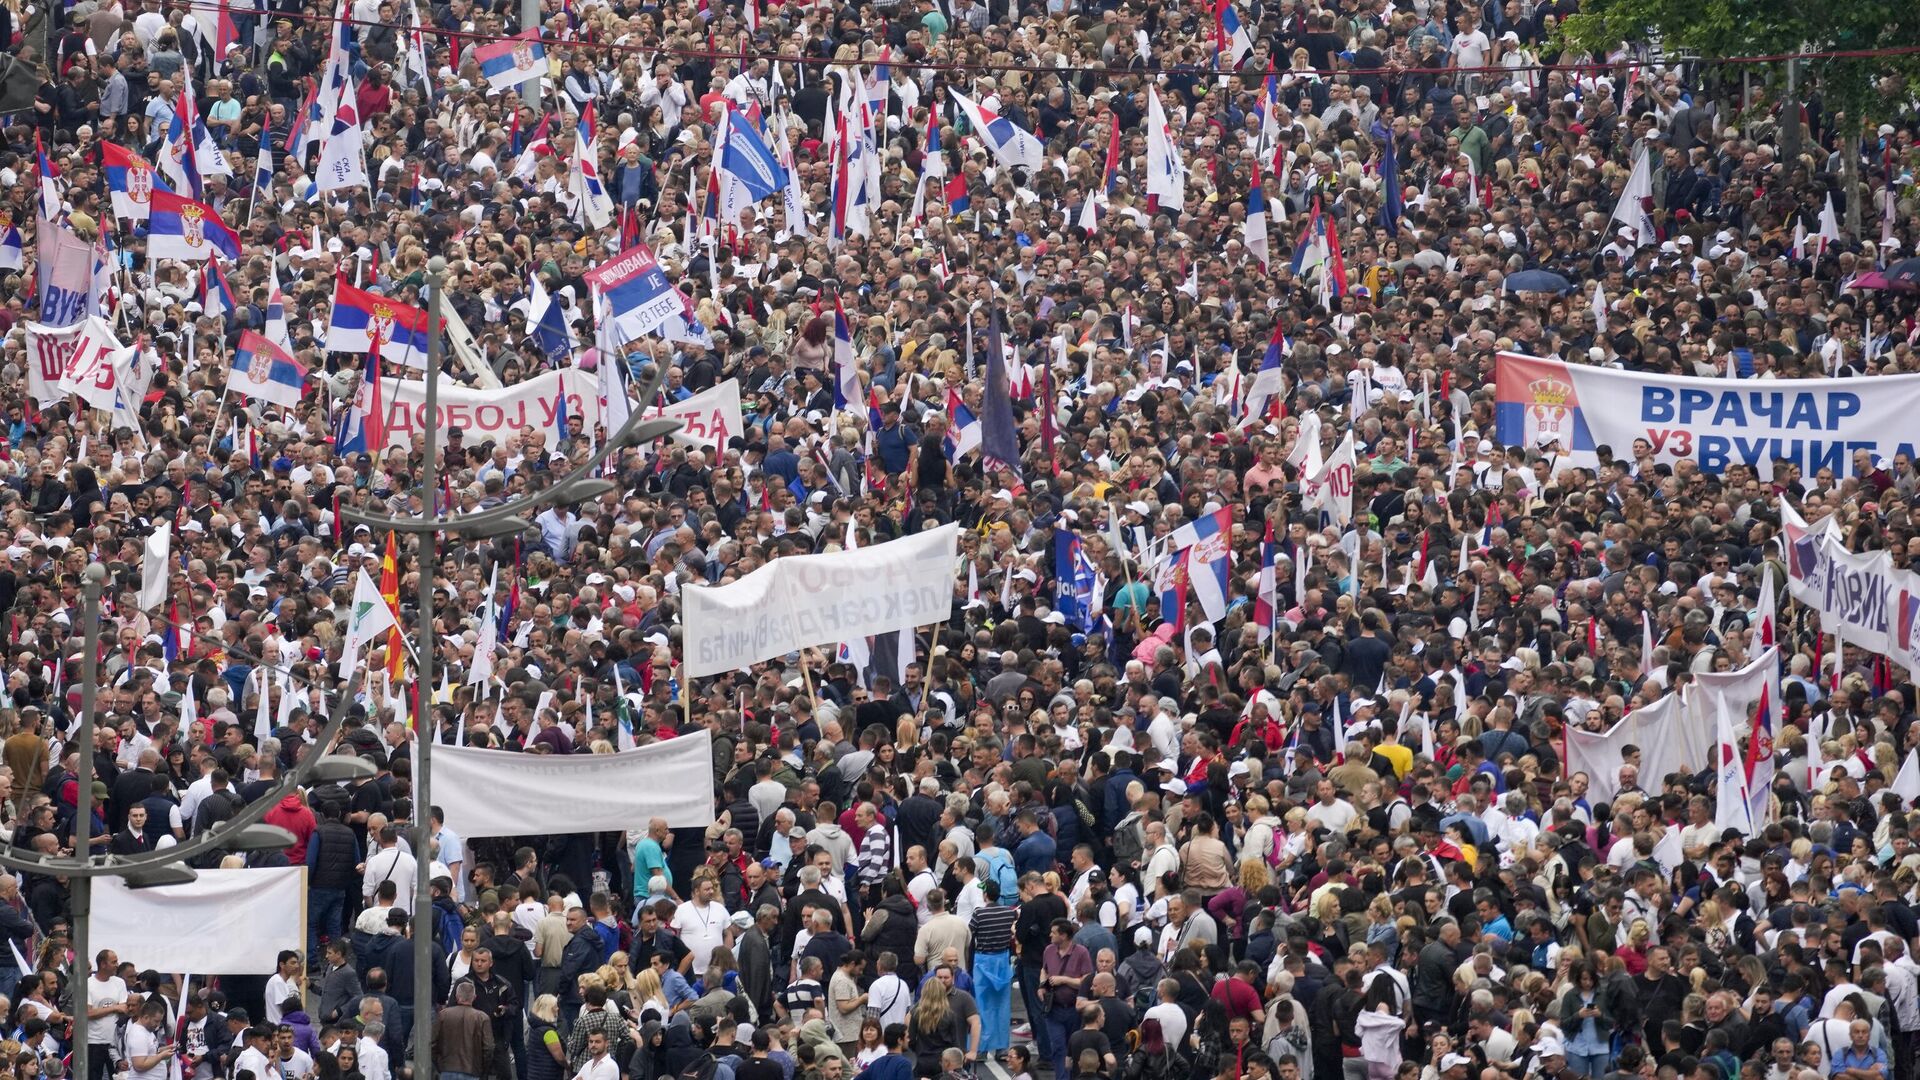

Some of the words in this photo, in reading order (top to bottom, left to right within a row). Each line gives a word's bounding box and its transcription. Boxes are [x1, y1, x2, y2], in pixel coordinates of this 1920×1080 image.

[647, 272, 663, 291] ЈЕ
[635, 310, 652, 329] УЗ
[648, 297, 677, 320] ТЕБЕ
[388, 400, 526, 437] ДОБОЈ
[538, 393, 584, 428] УЗ
[1641, 385, 1861, 431] ВРАЧАР
[1647, 428, 1692, 458] УЗ
